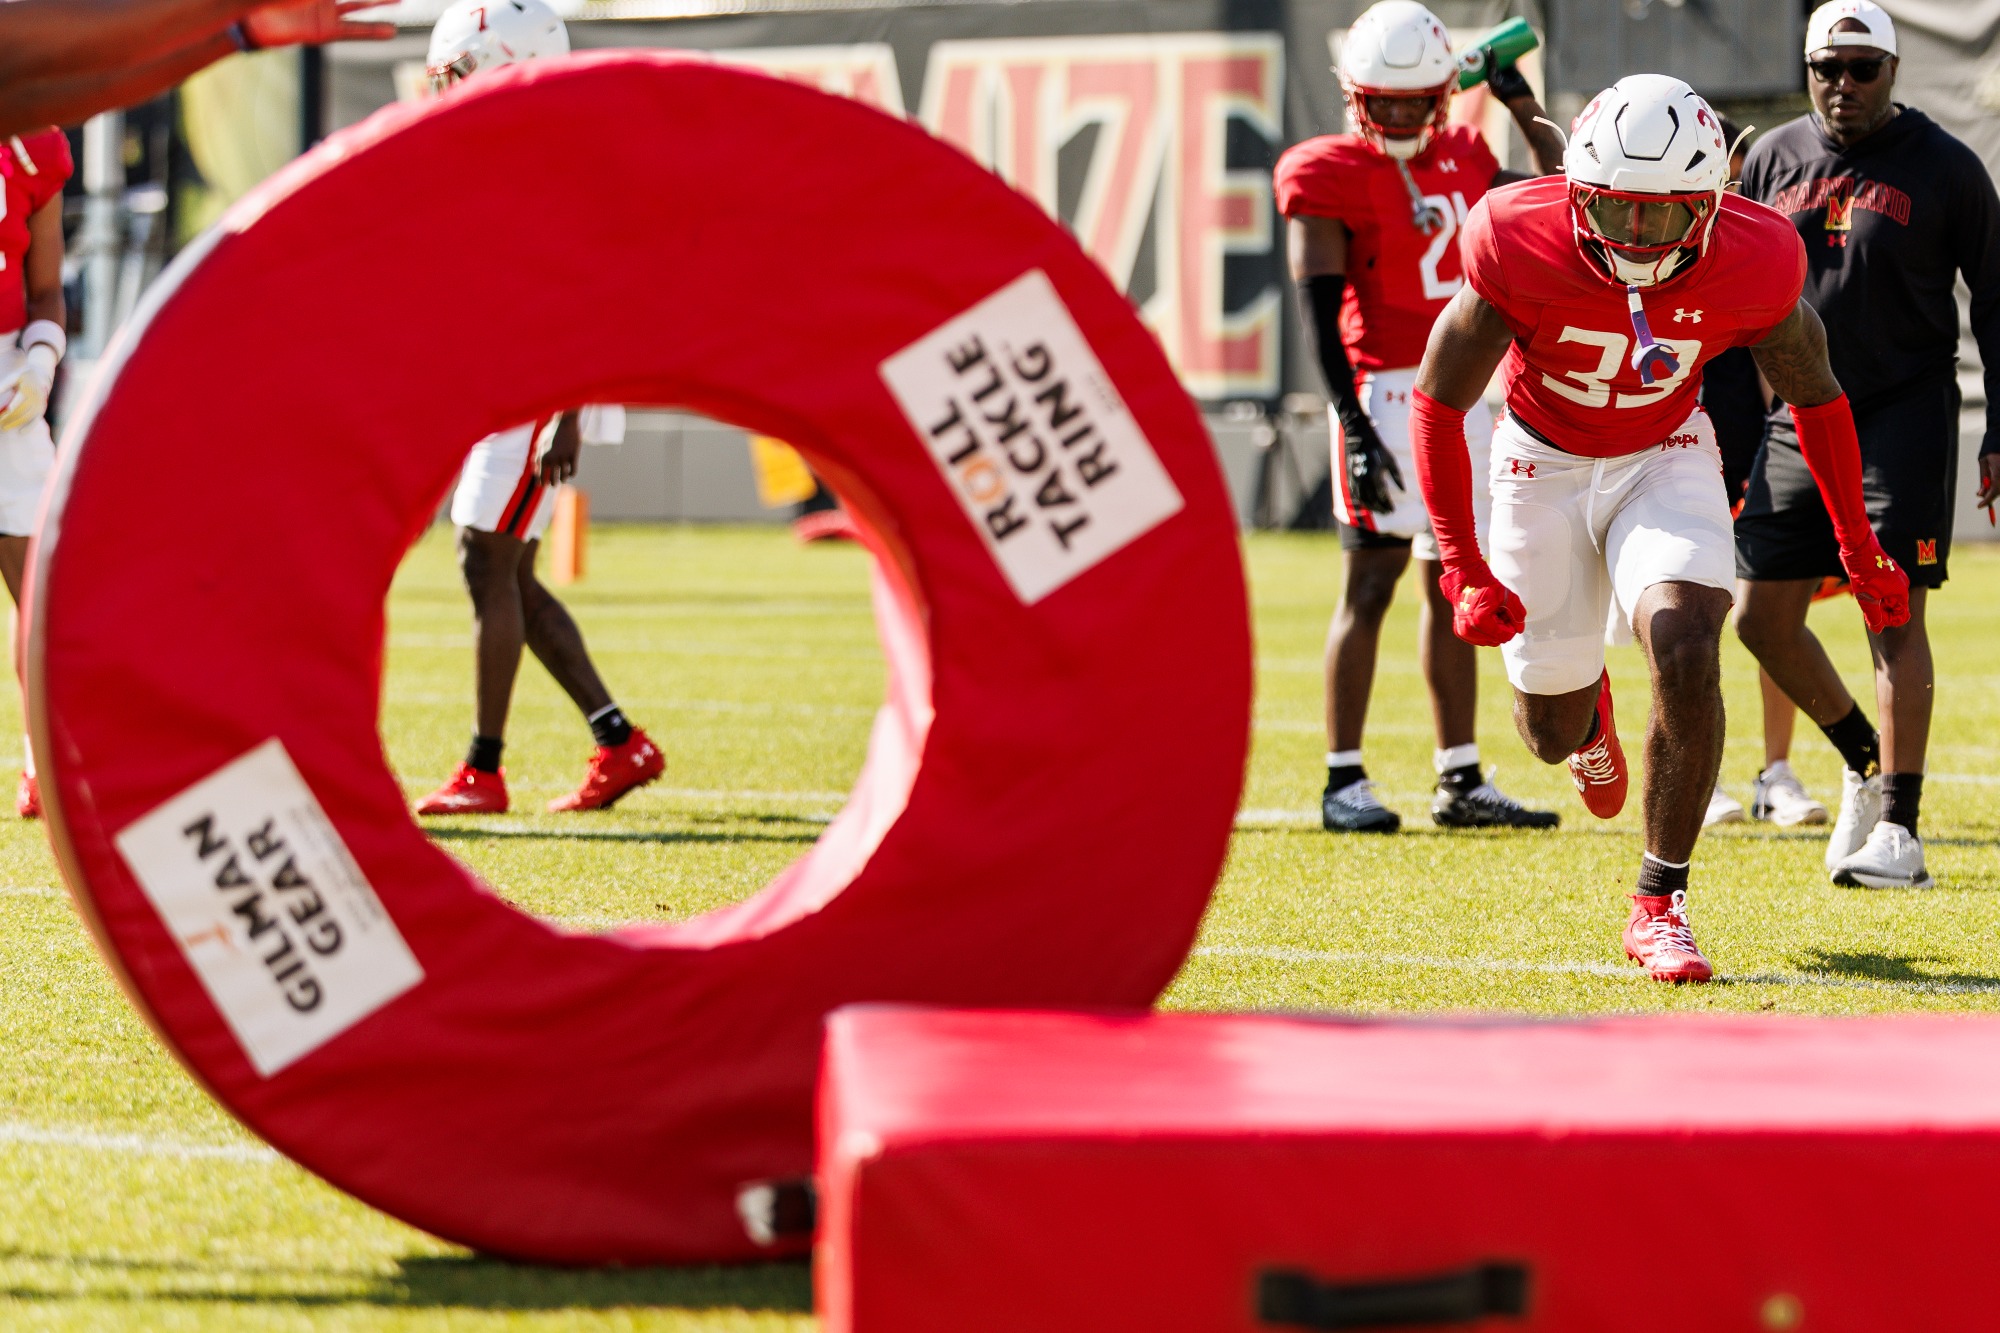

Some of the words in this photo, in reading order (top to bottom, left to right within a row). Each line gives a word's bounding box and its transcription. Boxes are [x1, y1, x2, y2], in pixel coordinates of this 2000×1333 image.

[469, 7, 488, 32] 7
[1775, 176, 1911, 226] MARYLAND
[1012, 343, 1118, 488] RING
[1541, 325, 1702, 409] 33
[931, 399, 1028, 541] ROLL
[946, 334, 1089, 553] TACKLE
[182, 811, 324, 1013] GILMAN
[247, 818, 342, 957] GEAR
